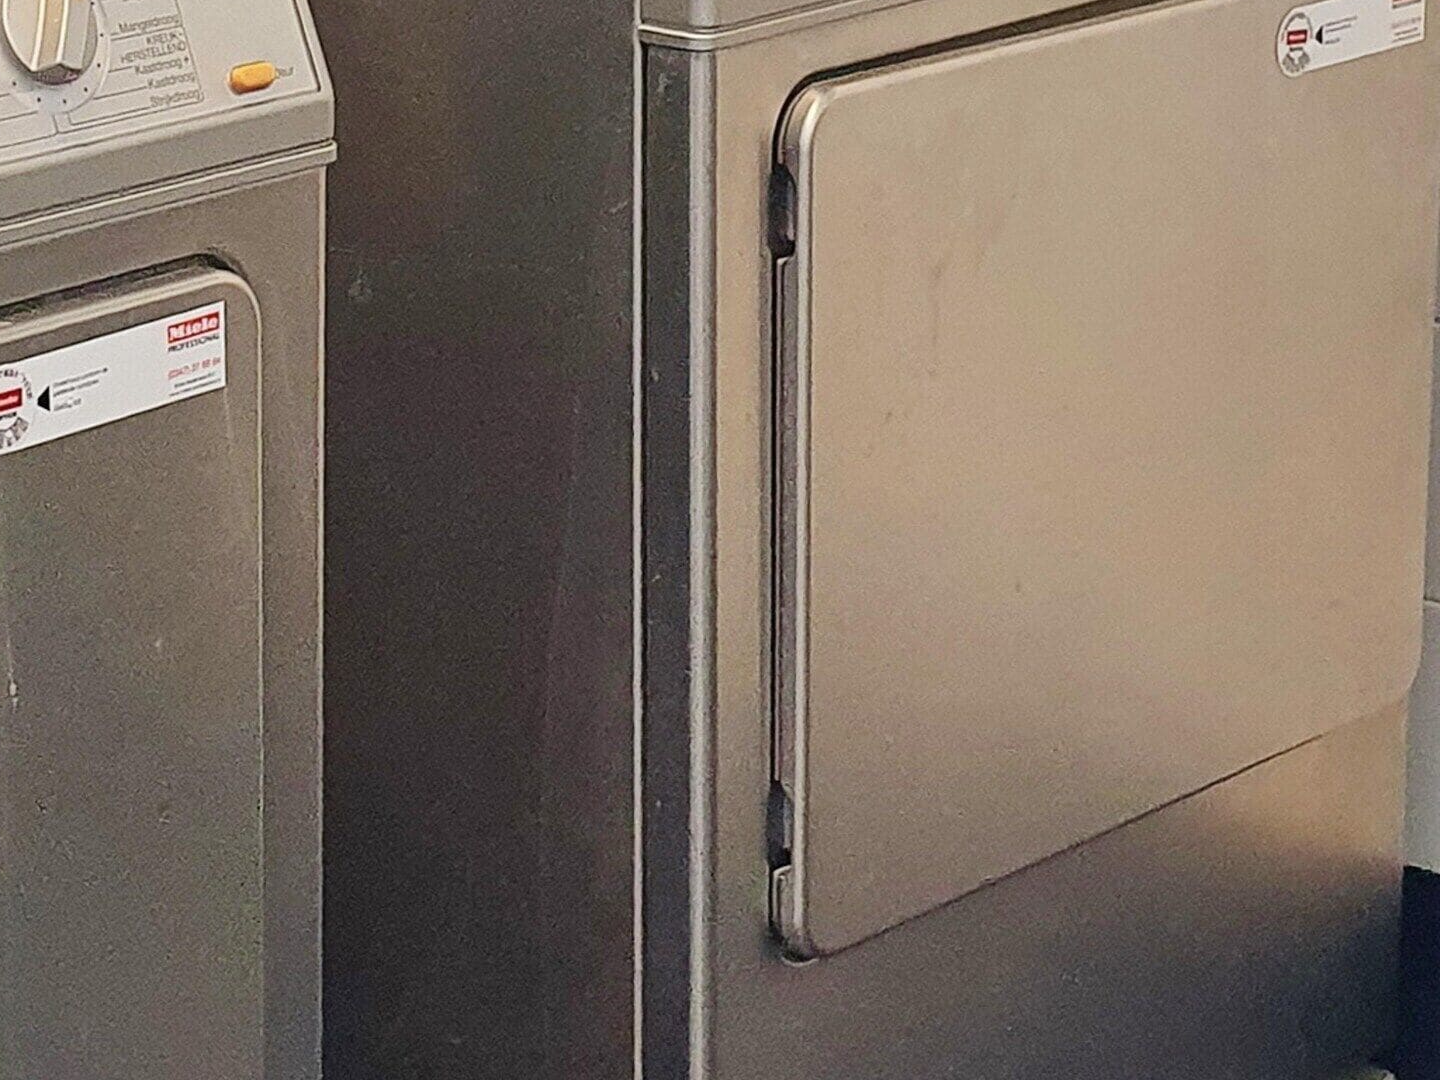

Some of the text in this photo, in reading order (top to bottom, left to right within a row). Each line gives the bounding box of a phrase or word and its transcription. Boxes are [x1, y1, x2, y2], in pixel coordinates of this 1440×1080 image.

[147, 72, 195, 89] Kastdroog
[168, 316, 219, 342] Miele
[168, 334, 220, 352] PROFESSIONAL
